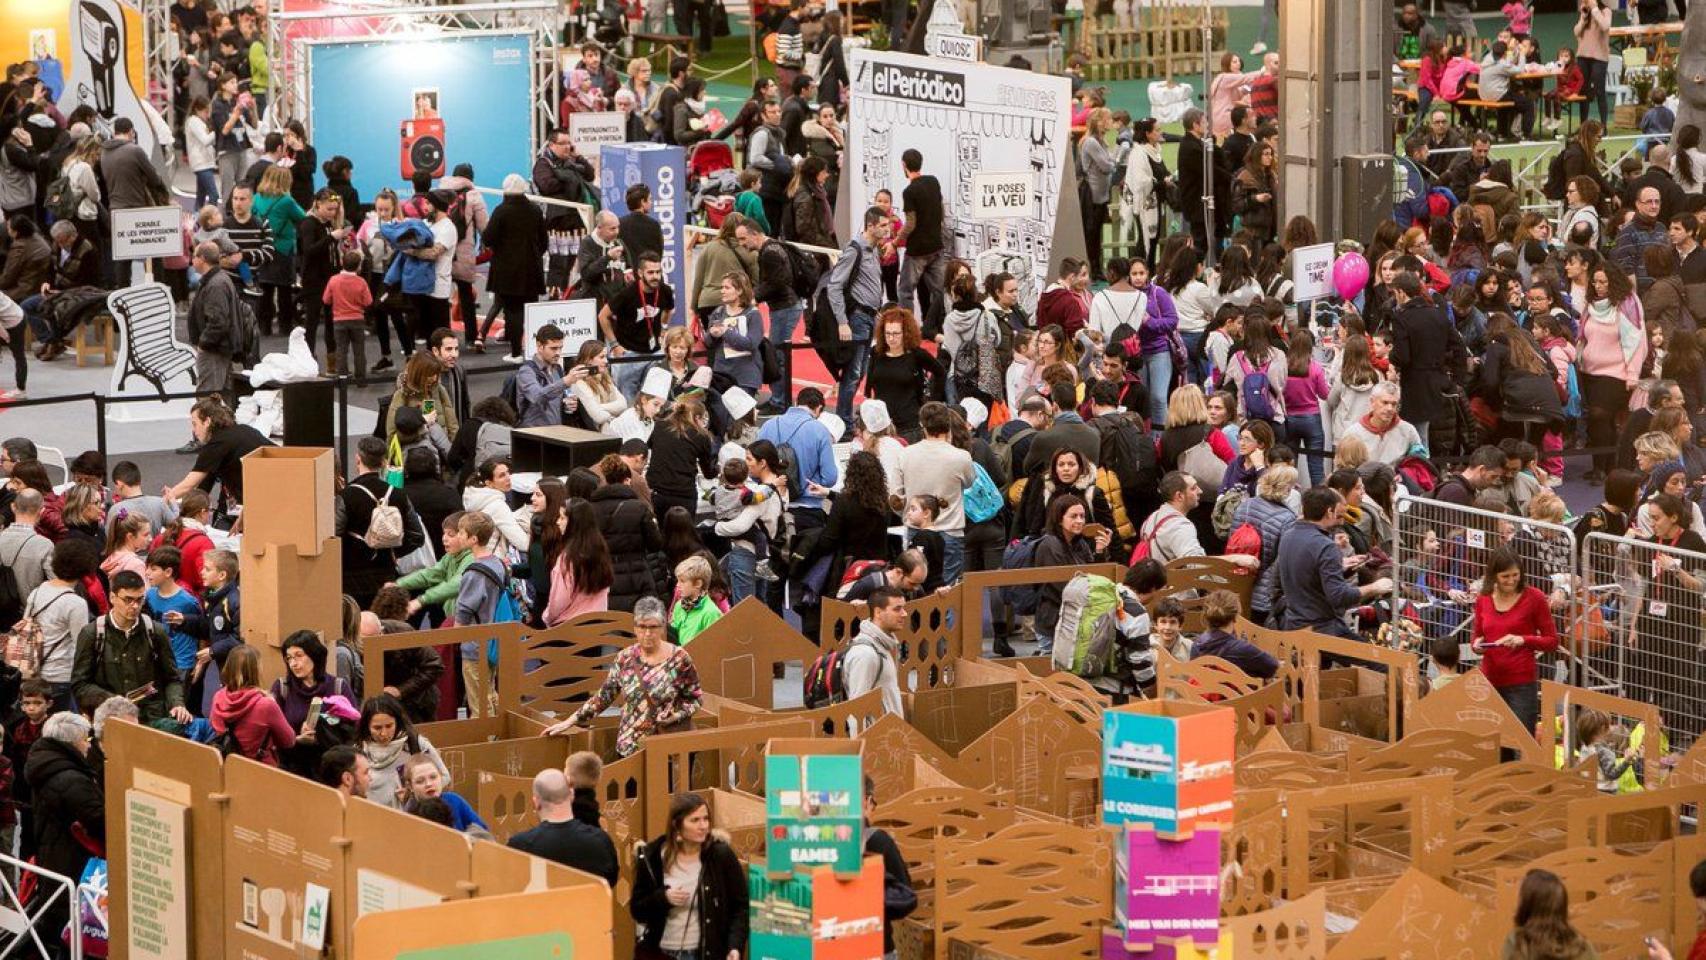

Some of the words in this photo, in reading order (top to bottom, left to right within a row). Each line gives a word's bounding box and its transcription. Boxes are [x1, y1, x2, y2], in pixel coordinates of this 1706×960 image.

[890, 68, 963, 105] Periódico
[983, 184, 995, 194] TU
[997, 182, 1026, 193] POSES
[982, 196, 997, 208] LA
[1001, 193, 1026, 207] VEU
[559, 316, 576, 325] PLAT
[790, 847, 839, 863] EAMES
[1151, 918, 1171, 930] VAN
[1172, 918, 1190, 930] DER
